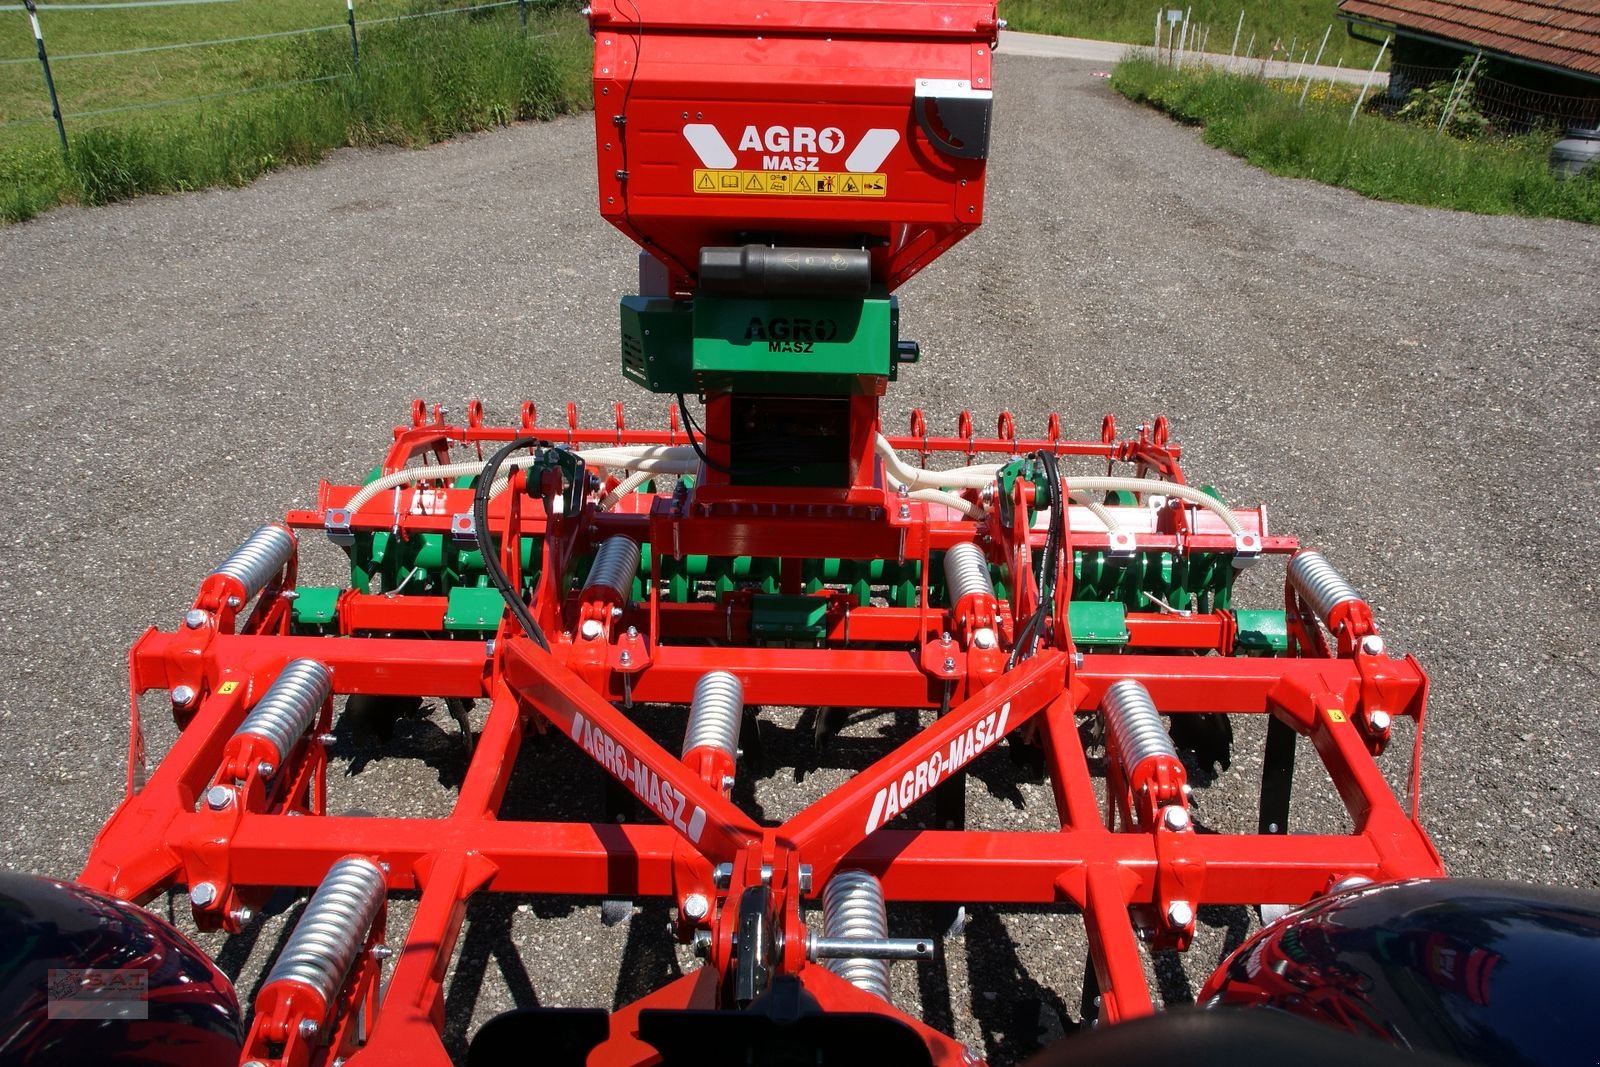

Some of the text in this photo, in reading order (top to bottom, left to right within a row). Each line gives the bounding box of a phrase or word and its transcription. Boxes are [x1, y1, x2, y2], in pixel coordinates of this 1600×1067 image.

[738, 125, 845, 153] AGRO
[763, 155, 819, 171] MASZ
[745, 317, 837, 341] AGRO
[769, 342, 814, 353] MASZ
[582, 721, 688, 833] AGRO-MASZ
[884, 711, 998, 822] AGRO-MASZ
